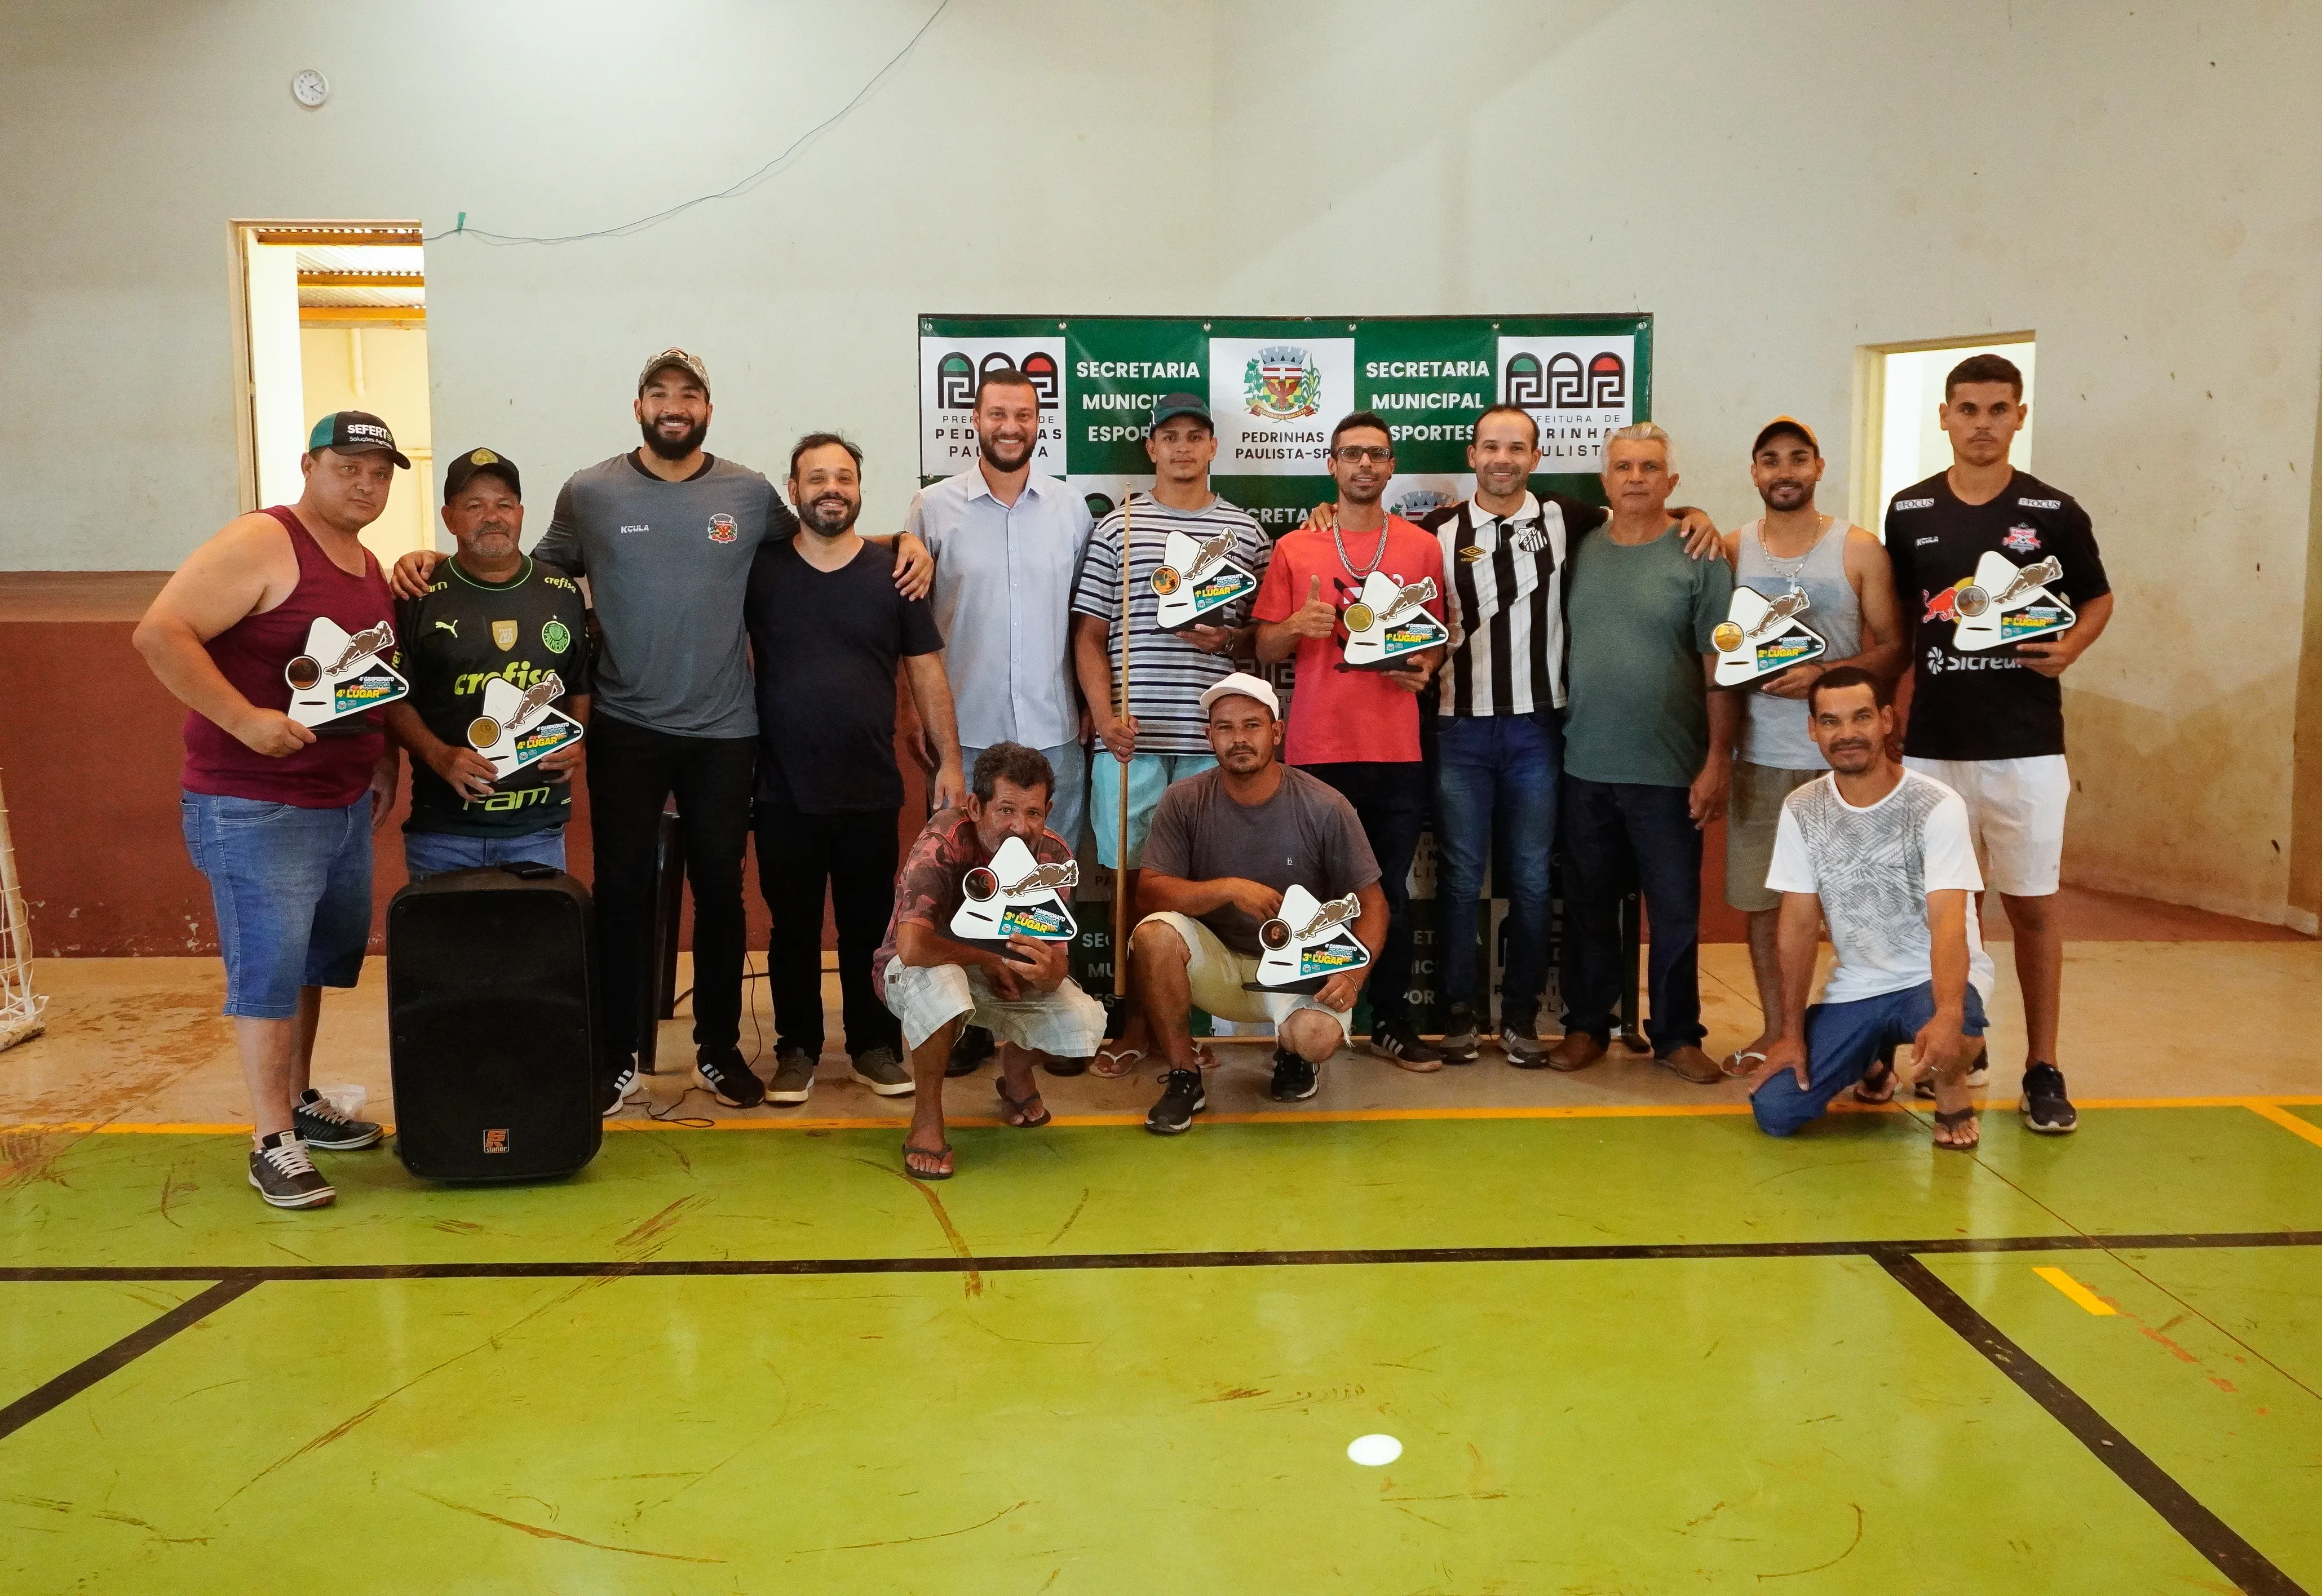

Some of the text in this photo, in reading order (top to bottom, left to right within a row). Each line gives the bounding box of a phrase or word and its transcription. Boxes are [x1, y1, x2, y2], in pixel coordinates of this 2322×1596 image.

[1077, 362, 1200, 378] SECRETARIA
[1365, 361, 1490, 377] SECRETARIA
[1082, 394, 1167, 410] MUNICI
[1372, 393, 1484, 409] MUNICIPAL
[1089, 427, 1151, 441] ESPOR
[1242, 432, 1324, 443] PEDRINHAS
[1389, 424, 1475, 441] SPORTES
[1236, 448, 1331, 459] PAULISTA-SP
[1903, 498, 1933, 508] FOCUS
[2027, 499, 2060, 509] FOCUS
[544, 576, 577, 593] crefisa
[1202, 587, 1230, 597] LUGAR
[1393, 633, 1423, 642] LUGAR
[347, 689, 380, 698] LUGAR
[527, 736, 558, 748] LUGAR
[1036, 908, 1065, 922] CAMPEONATO
[1014, 915, 1048, 933] LUGAR
[1040, 915, 1060, 928] SINUCA
[1335, 949, 1353, 957] SINUCA
[1312, 954, 1343, 965] LUGAR
